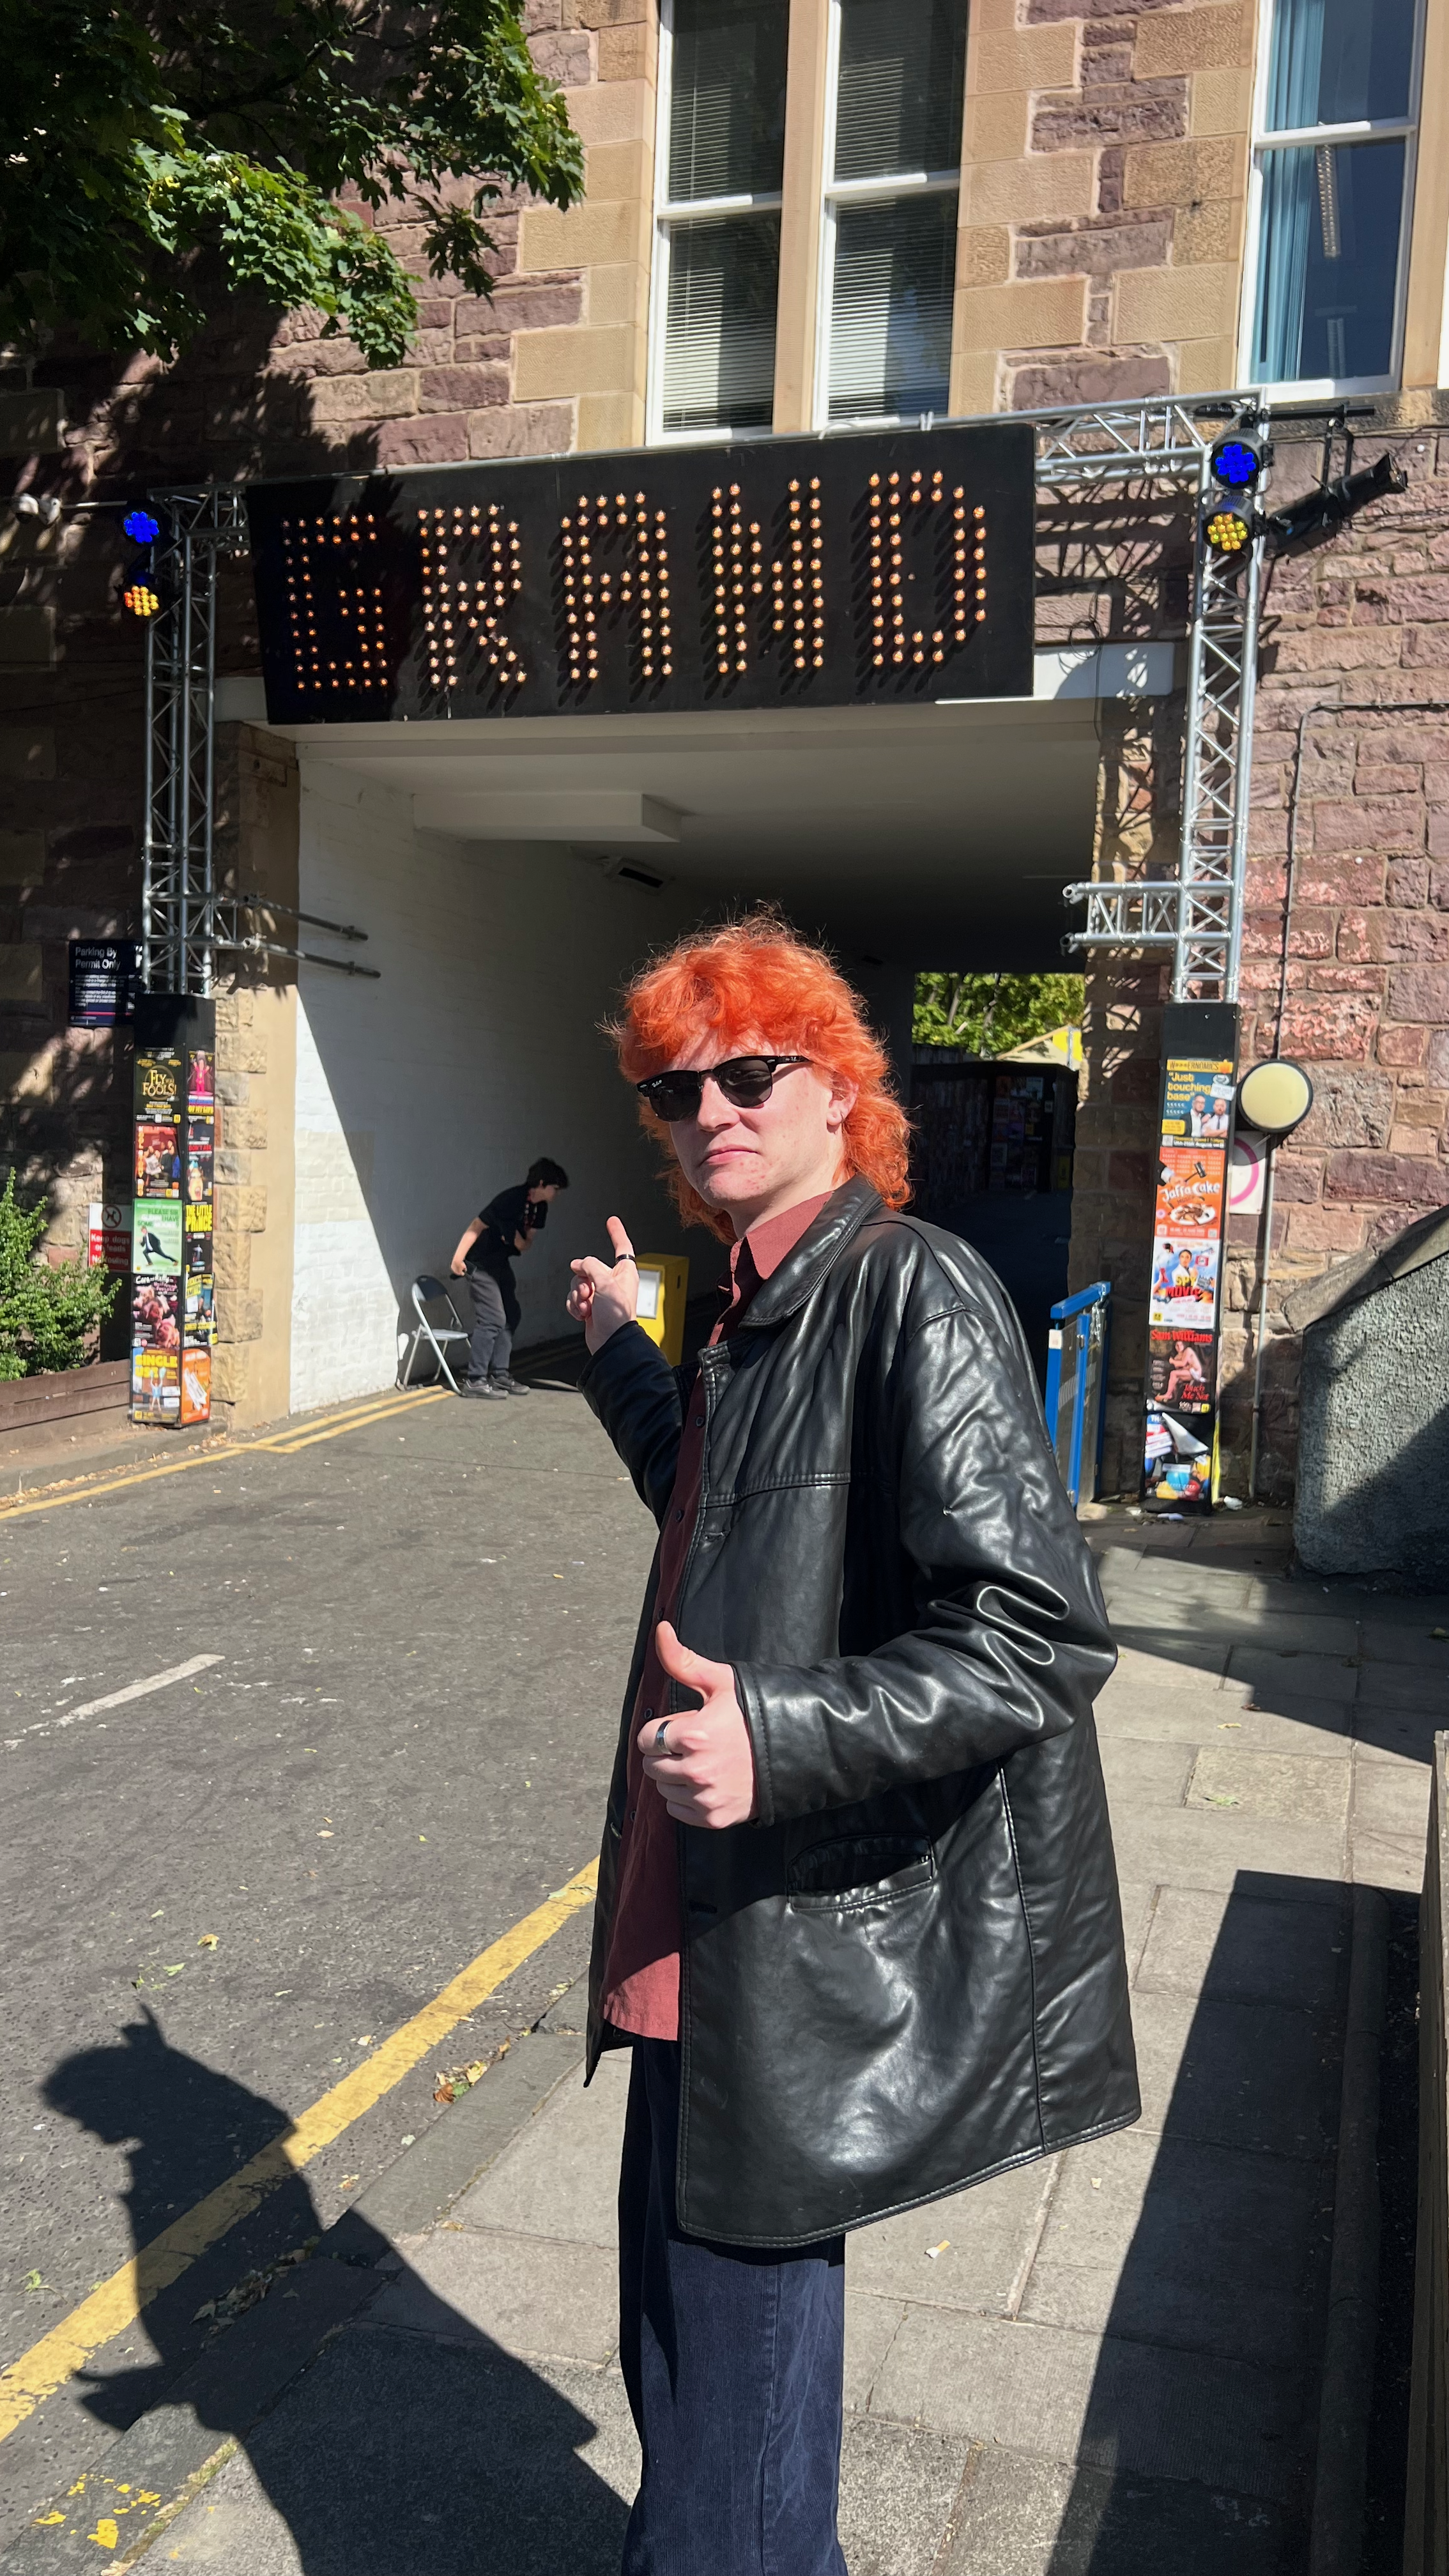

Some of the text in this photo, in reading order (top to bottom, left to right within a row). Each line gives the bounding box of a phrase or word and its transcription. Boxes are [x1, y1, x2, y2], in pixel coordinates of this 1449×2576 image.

[282, 468, 986, 691] GRAND
[75, 947, 117, 958] Parking By
[75, 959, 121, 970] Permit Only
[150, 1070, 167, 1086] FLY
[142, 1082, 177, 1097] FOOLS!
[1167, 1082, 1211, 1095] touching
[1160, 1184, 1192, 1202] Jaffa
[1192, 1181, 1220, 1196] Cake
[186, 1205, 195, 1216] THE
[196, 1205, 212, 1216] LITTLE
[185, 1215, 212, 1232] PRINCE
[91, 1233, 130, 1245] Keep dogs
[107, 1244, 126, 1252] leads
[1176, 1275, 1197, 1287] SPY
[1151, 1329, 1213, 1343] Sam Williams
[135, 1354, 178, 1368] SINGLE
[135, 1366, 159, 1379] USE
